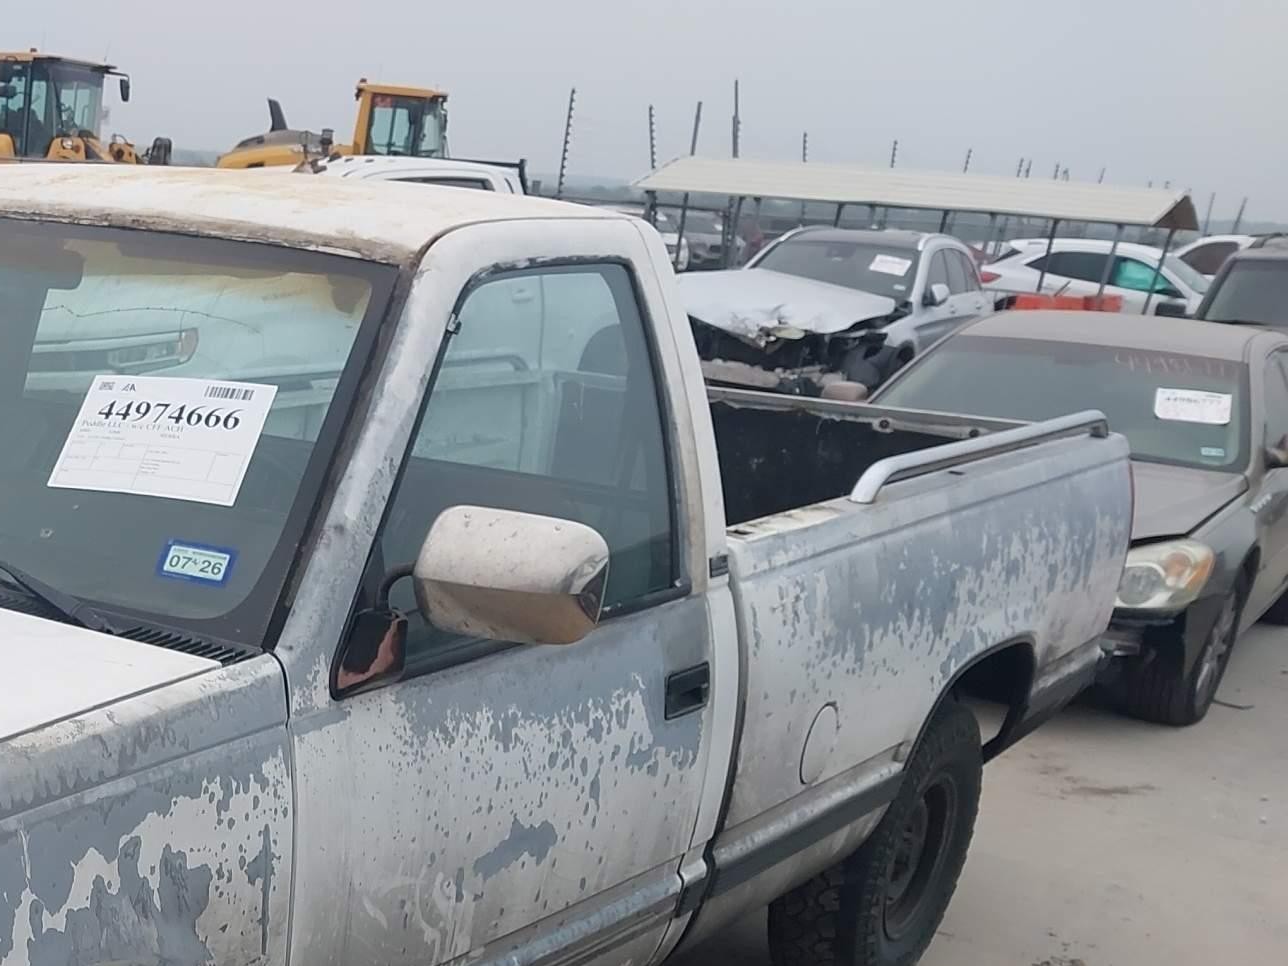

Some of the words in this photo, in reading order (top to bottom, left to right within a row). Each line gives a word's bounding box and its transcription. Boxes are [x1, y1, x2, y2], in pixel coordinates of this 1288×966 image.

[98, 399, 245, 430] 44974666
[168, 554, 193, 570] 07
[199, 559, 223, 576] 26
